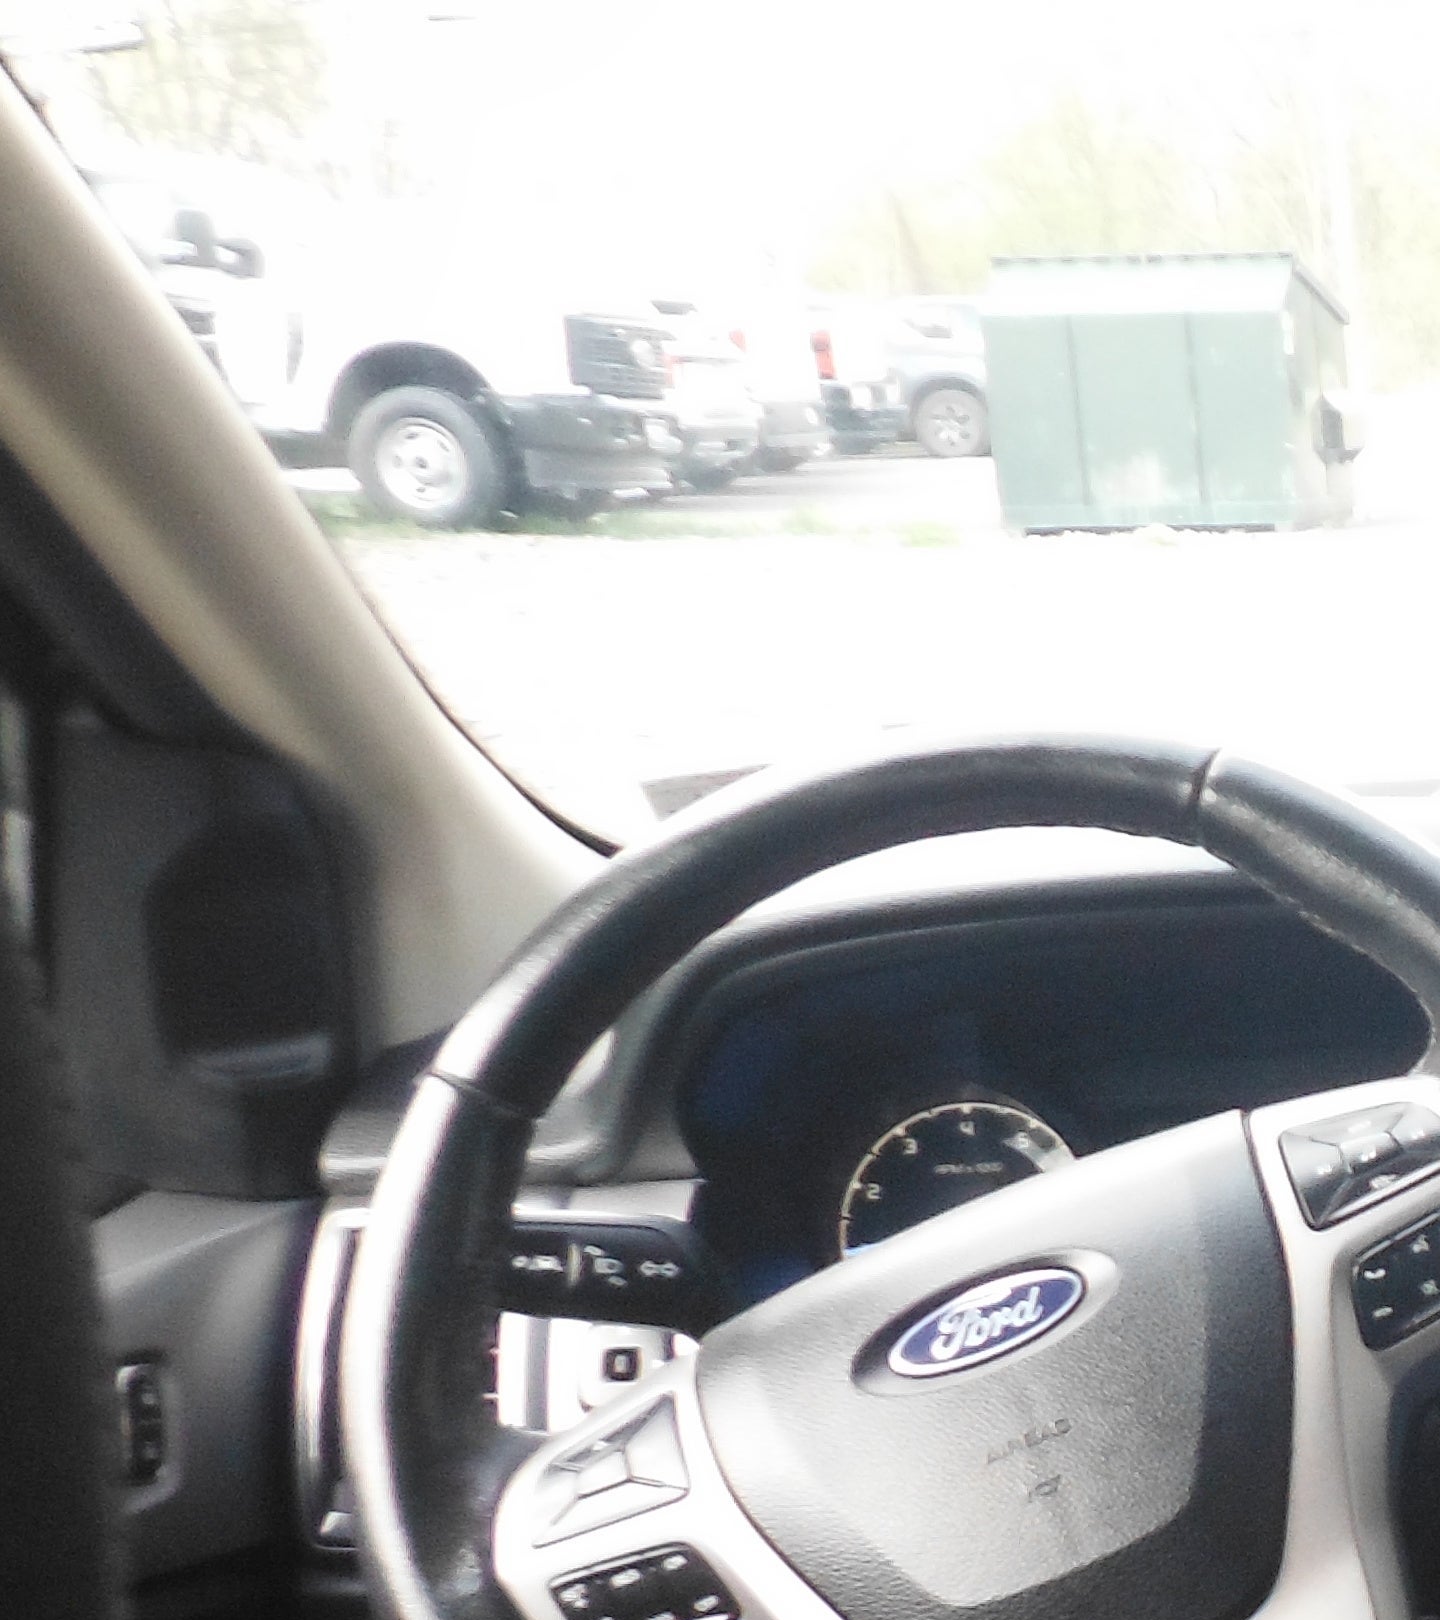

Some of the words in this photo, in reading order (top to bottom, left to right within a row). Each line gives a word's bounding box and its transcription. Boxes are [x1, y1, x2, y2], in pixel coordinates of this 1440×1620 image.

[960, 1120, 975, 1136] 4
[902, 1137, 918, 1155] 3
[866, 1183, 882, 1200] 2
[930, 1285, 1045, 1361] Ford
